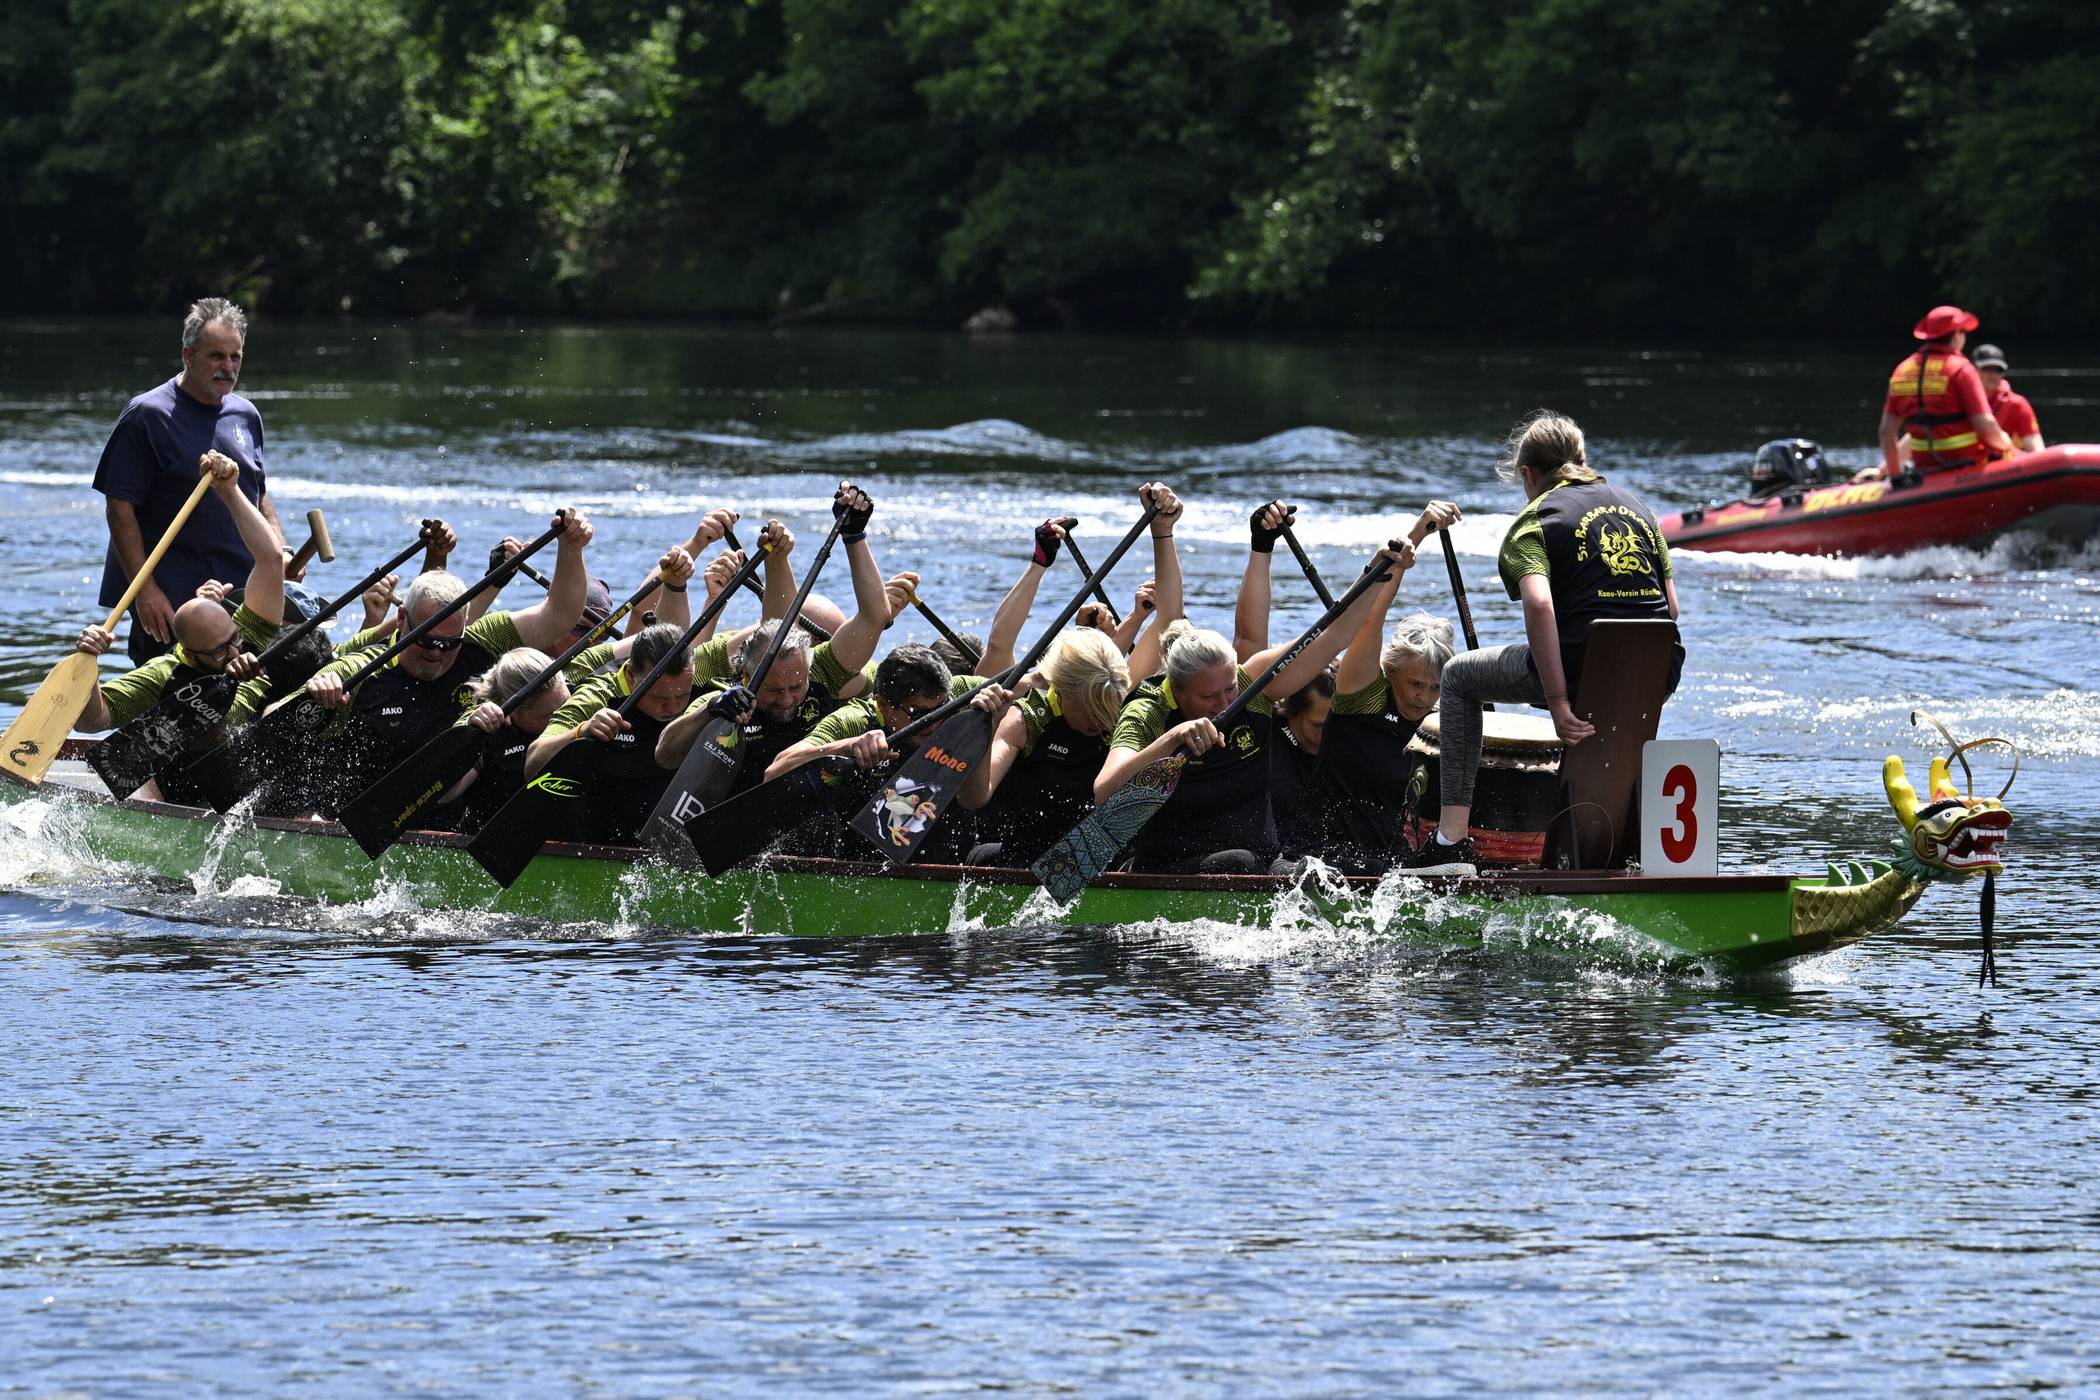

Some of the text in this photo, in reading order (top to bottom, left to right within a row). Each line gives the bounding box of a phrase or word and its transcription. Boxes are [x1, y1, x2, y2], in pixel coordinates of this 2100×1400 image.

[1575, 505, 1617, 538] BARBARA
[1271, 627, 1322, 678] HORNET
[173, 682, 223, 724] Ocean
[381, 706, 403, 716] JAKO
[614, 733, 635, 743] JAKO
[1281, 726, 1298, 746] JAKO
[504, 744, 525, 756] JAKO
[717, 749, 736, 766] SPORT
[924, 746, 968, 773] Mone
[1047, 743, 1070, 755] JAKO
[526, 772, 582, 798] Kober
[1660, 764, 1698, 864] 3
